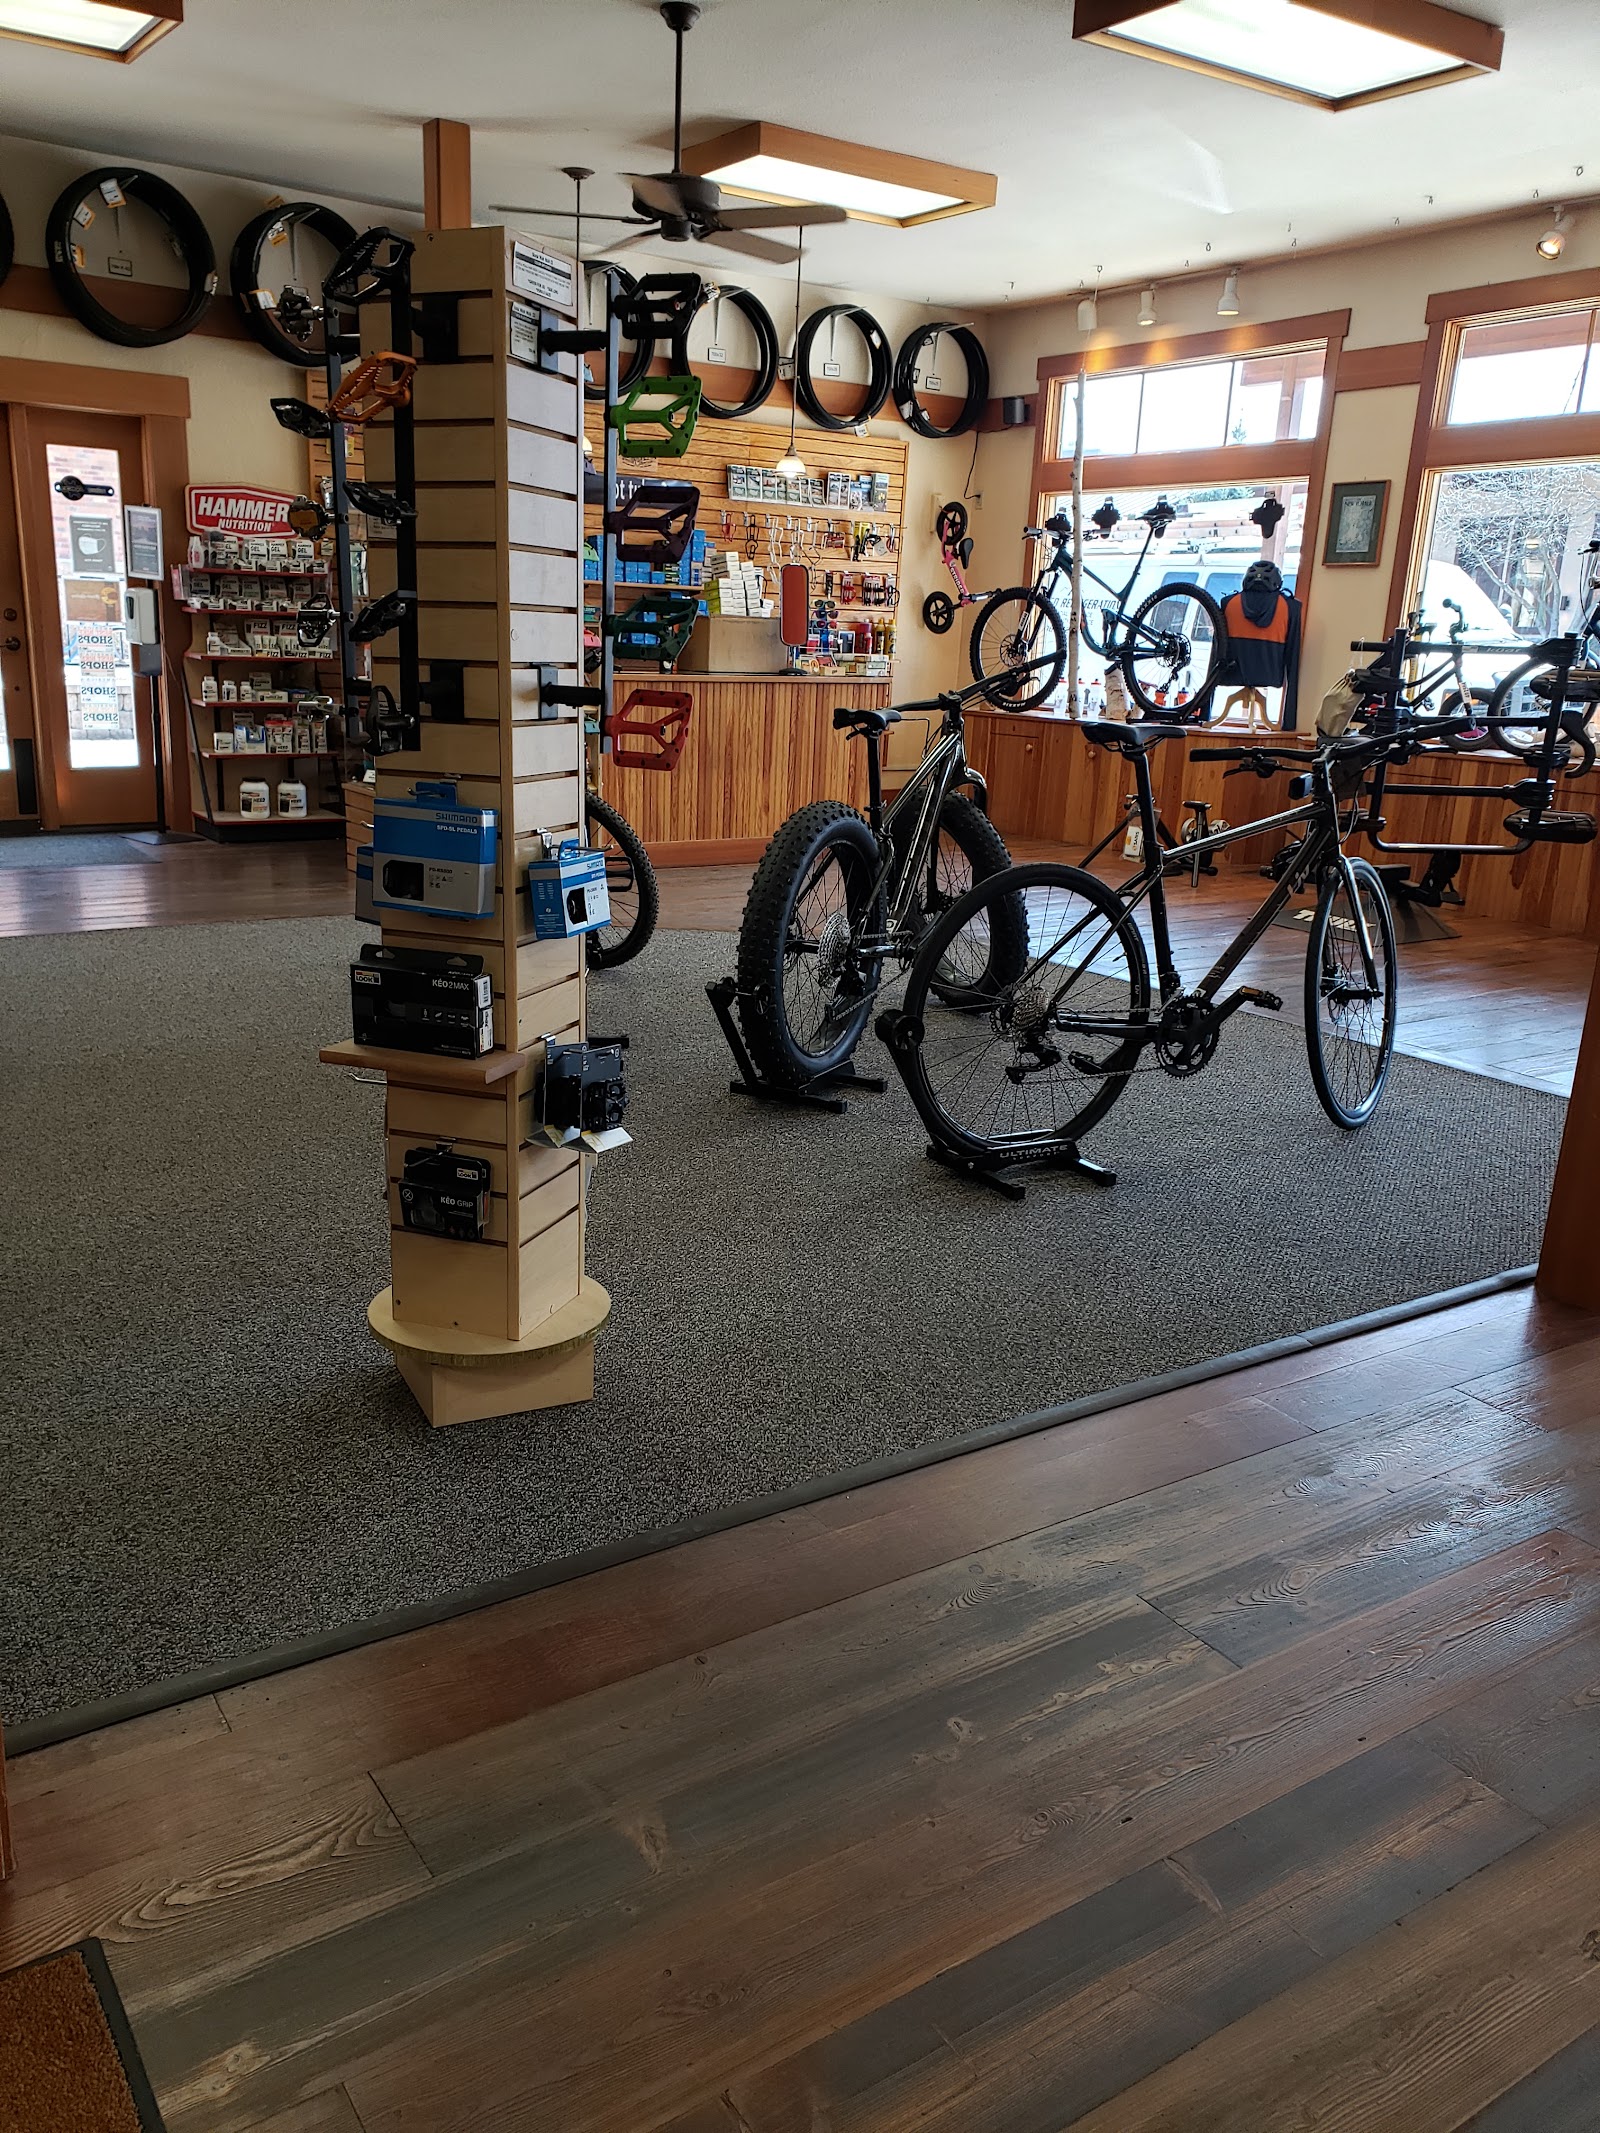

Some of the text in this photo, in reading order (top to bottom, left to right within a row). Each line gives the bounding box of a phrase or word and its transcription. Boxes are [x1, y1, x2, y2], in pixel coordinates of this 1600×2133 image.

[197, 495, 290, 523] HAMMER
[218, 518, 272, 532] NUTRITION
[435, 812, 478, 824] SHIMANO
[436, 824, 456, 832] SPD-SL
[356, 975, 375, 983] LOOK
[1000, 1144, 1068, 1158] ULTIMATE
[440, 1195, 474, 1209] KÉO GRIP
